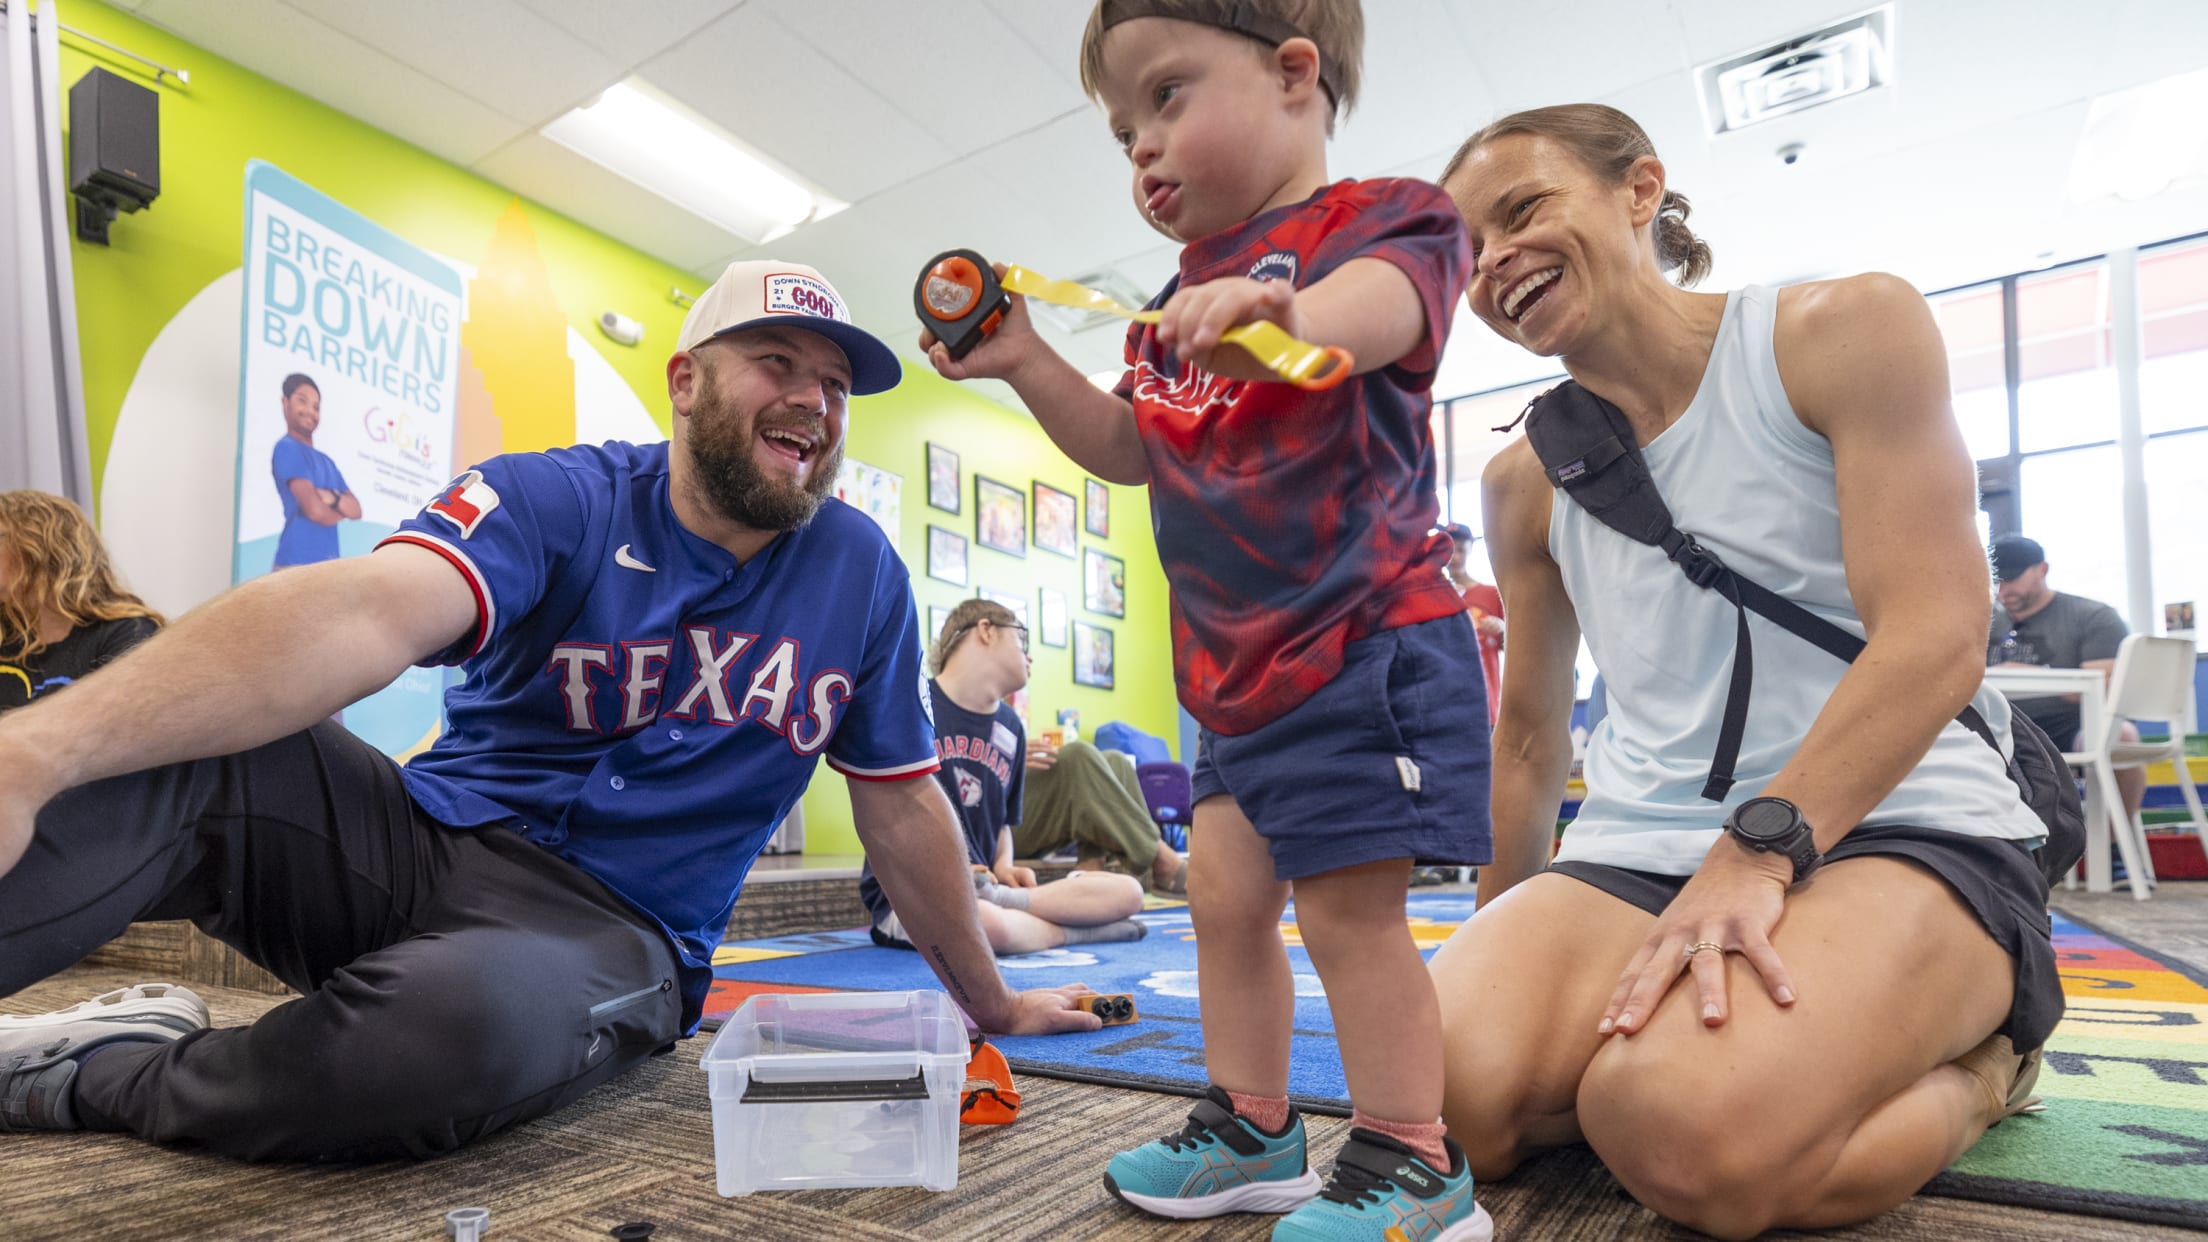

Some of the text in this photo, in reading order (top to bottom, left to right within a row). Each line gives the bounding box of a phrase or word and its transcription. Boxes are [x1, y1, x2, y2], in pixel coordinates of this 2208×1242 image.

[264, 251, 447, 383] DOWN
[266, 214, 449, 333] BREAKING
[264, 309, 441, 414] BARRIERS
[547, 624, 853, 756] TEXAS
